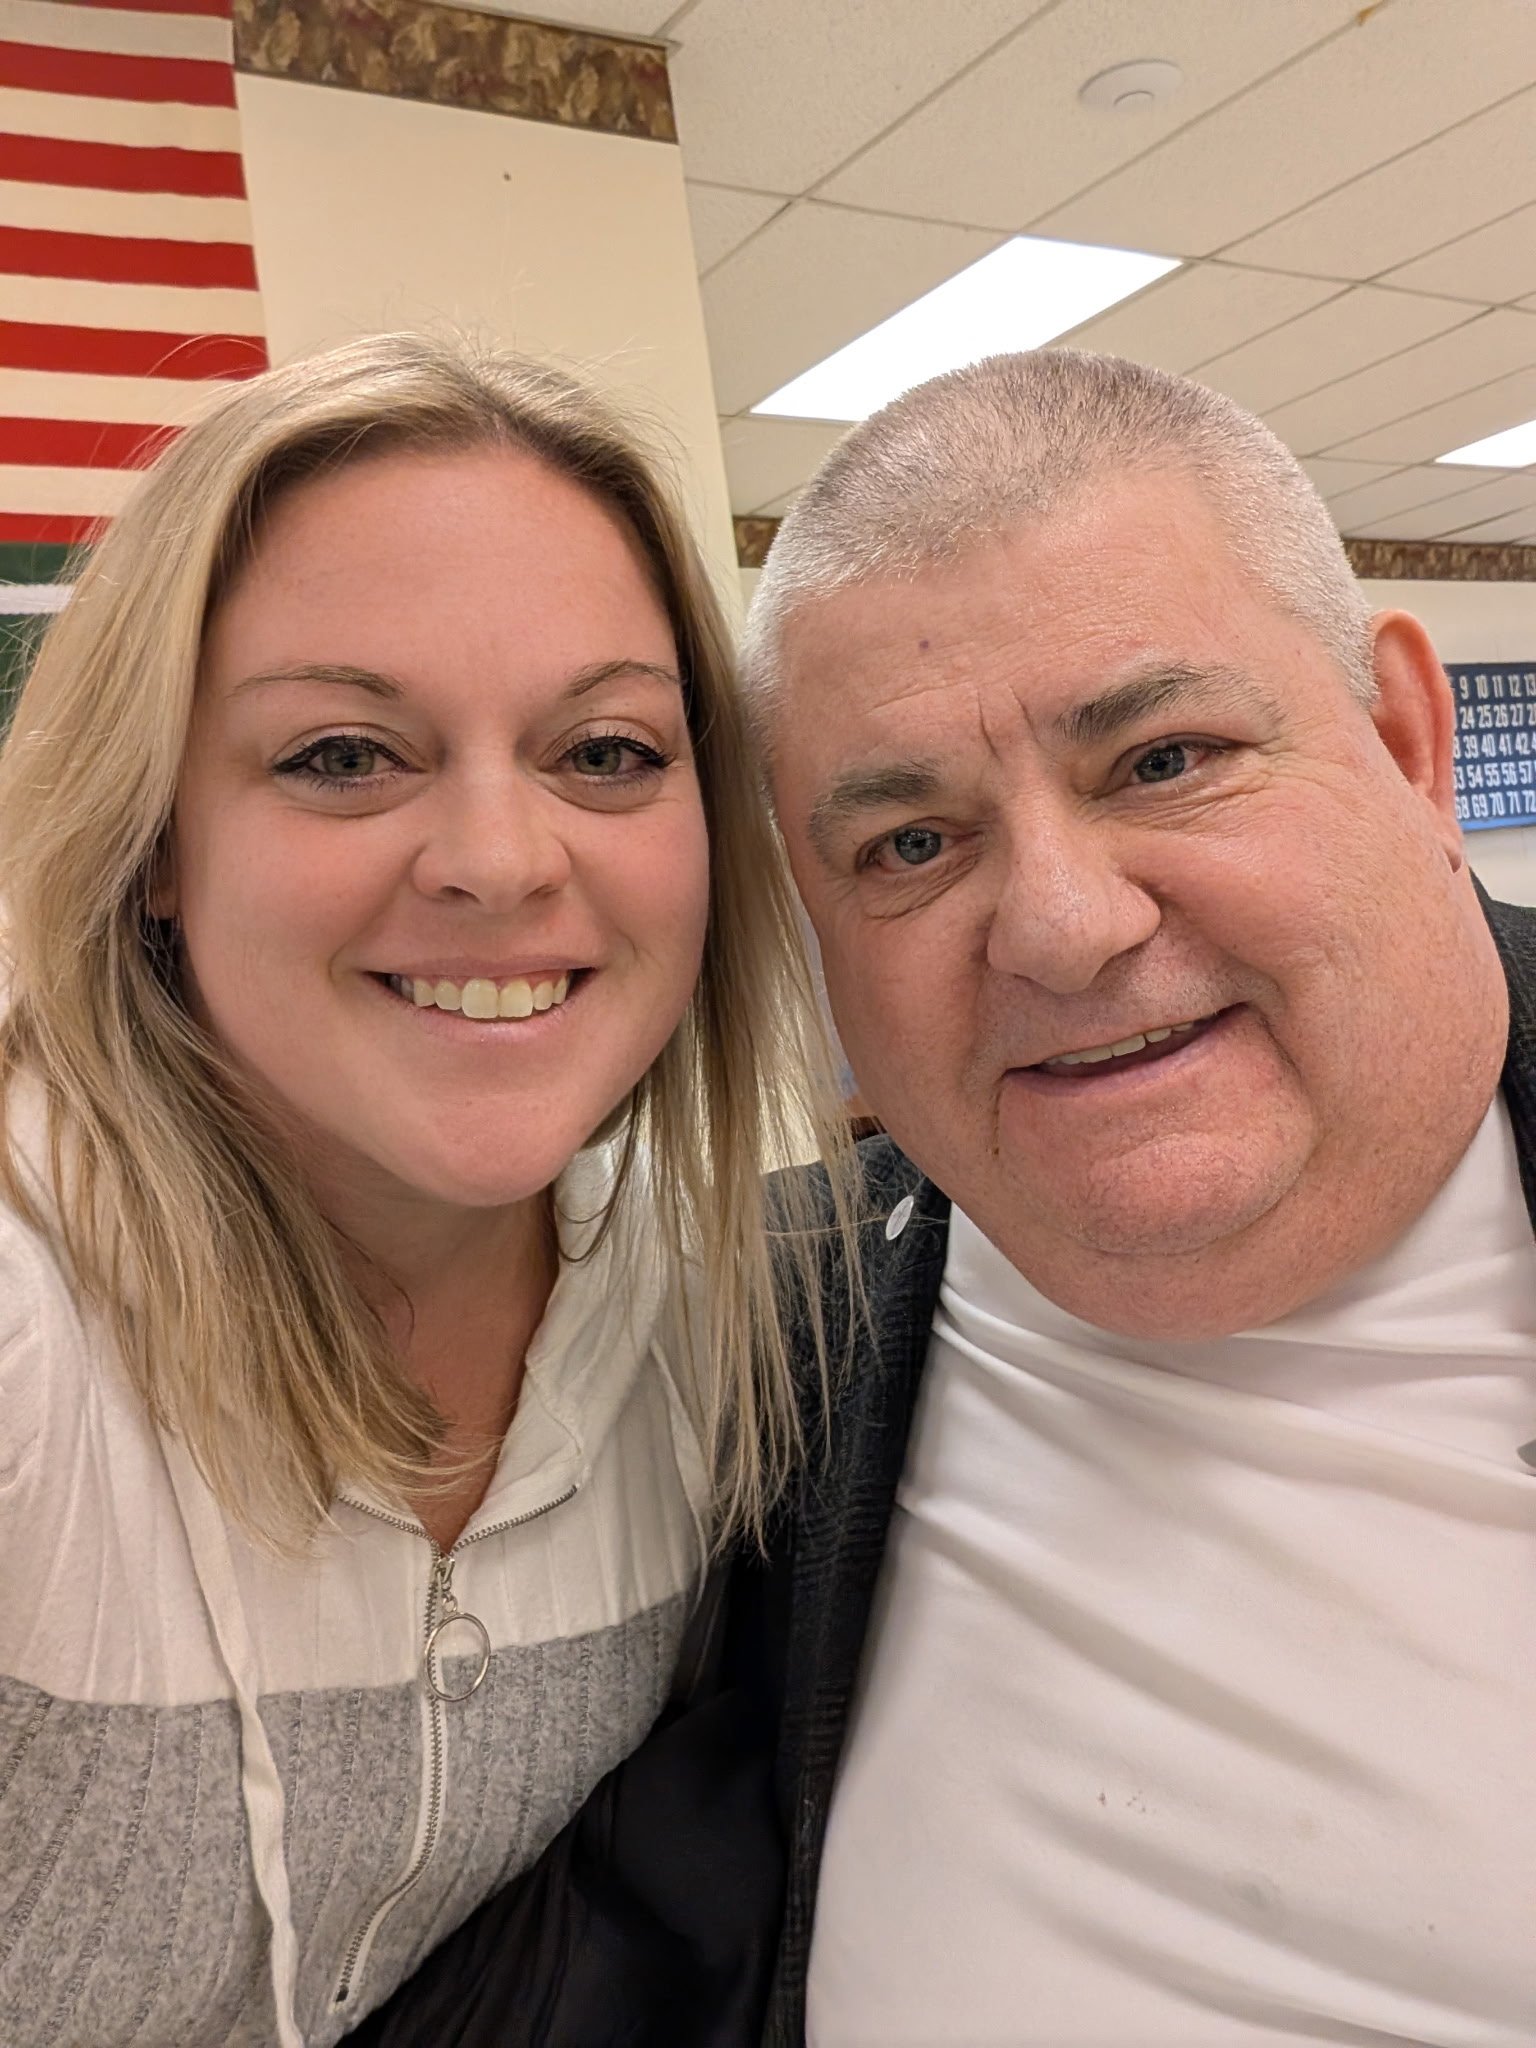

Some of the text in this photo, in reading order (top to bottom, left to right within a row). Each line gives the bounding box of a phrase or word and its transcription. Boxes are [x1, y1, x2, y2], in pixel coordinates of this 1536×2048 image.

[1459, 675, 1469, 699] 9
[1475, 674, 1488, 699] 10
[1492, 675, 1503, 698] 11
[1507, 674, 1521, 697] 12
[1459, 705, 1475, 729] 24
[1477, 704, 1493, 728] 25
[1493, 703, 1509, 728] 26
[1510, 703, 1524, 727] 27
[1463, 735, 1479, 759] 39
[1481, 733, 1496, 757] 40
[1499, 733, 1512, 756] 41
[1515, 732, 1531, 755] 42
[1466, 764, 1483, 788] 54
[1484, 763, 1500, 787] 55
[1501, 762, 1518, 786] 56
[1518, 761, 1532, 784] 57
[1455, 790, 1536, 819] 68 69 70 71 72
